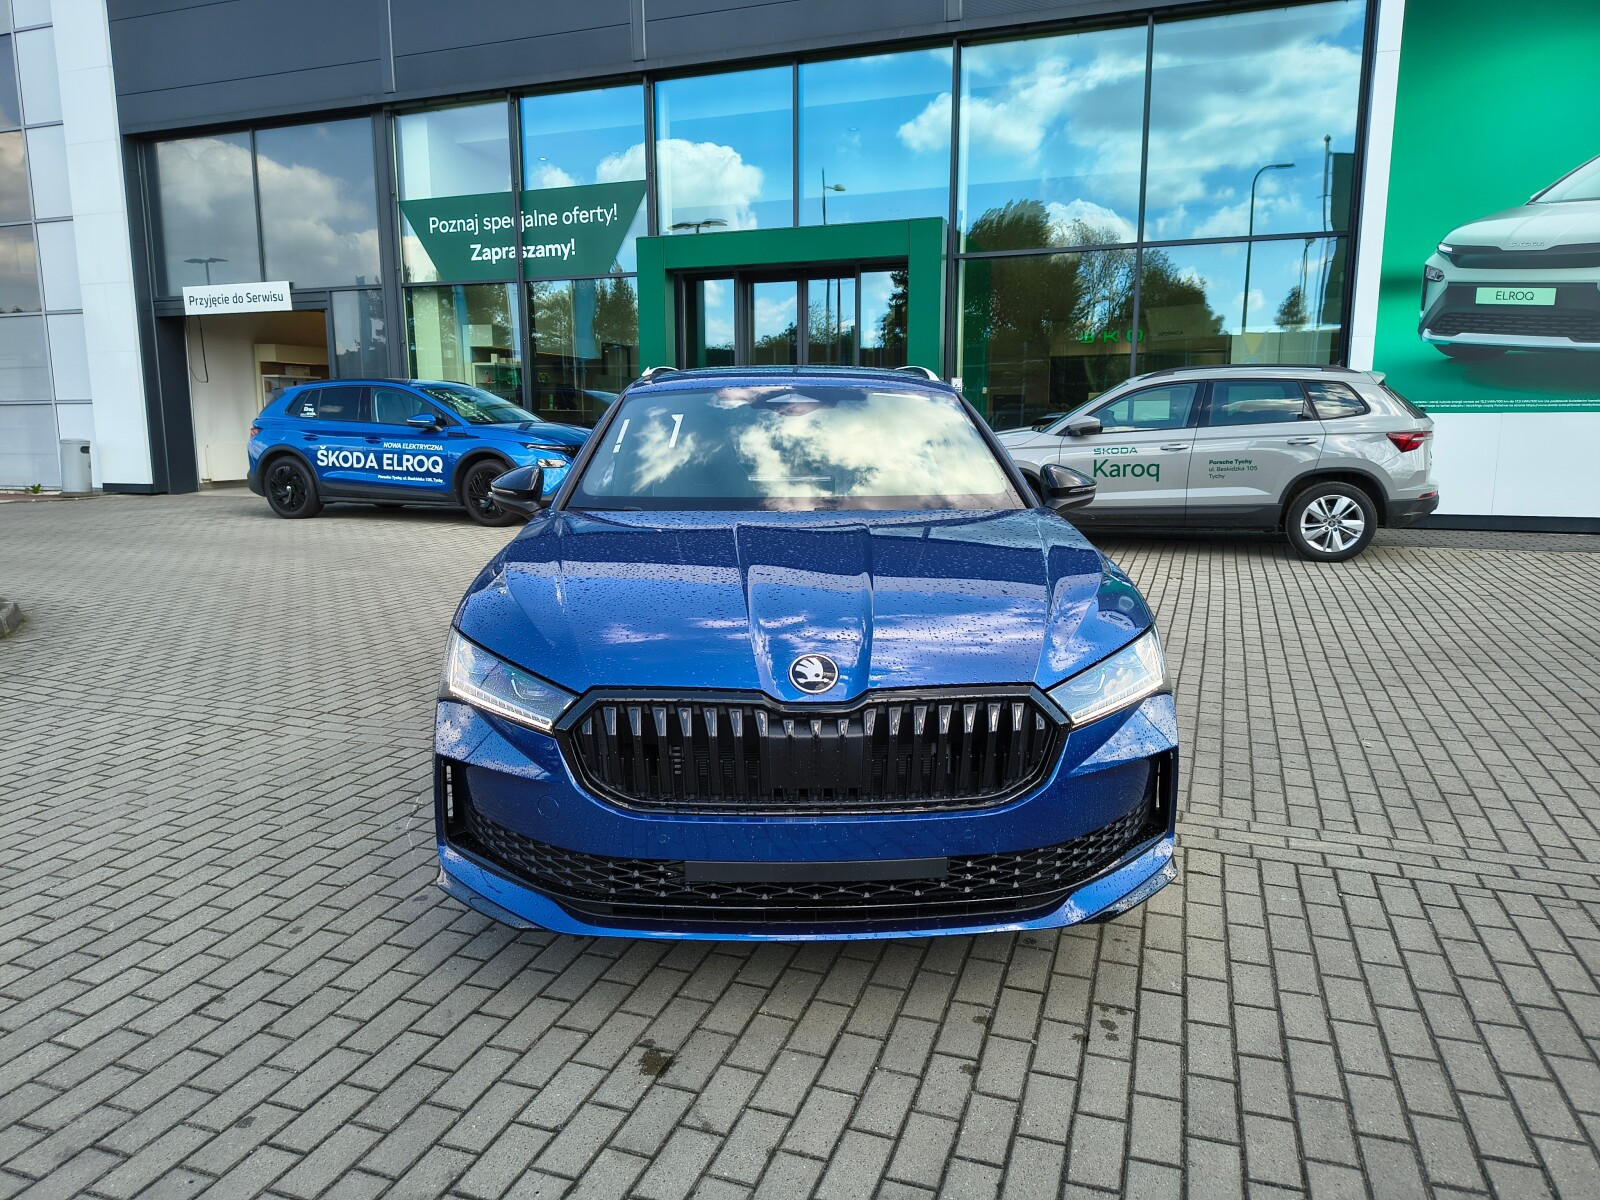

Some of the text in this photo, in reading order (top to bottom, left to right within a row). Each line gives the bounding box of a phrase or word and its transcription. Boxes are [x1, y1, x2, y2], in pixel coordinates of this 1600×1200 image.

[428, 213, 479, 235] Poznaj
[562, 203, 619, 226] oferty!
[469, 238, 576, 264] Zapraszamy!
[188, 291, 284, 308] Przyjęcie do Serwisu
[1495, 291, 1535, 301] ELROQ
[402, 443, 443, 451] ELEKTRYCZNA
[316, 445, 443, 474] ŠKODA ELROQ
[1234, 458, 1253, 466] Tychy
[1093, 459, 1160, 482] Karoq
